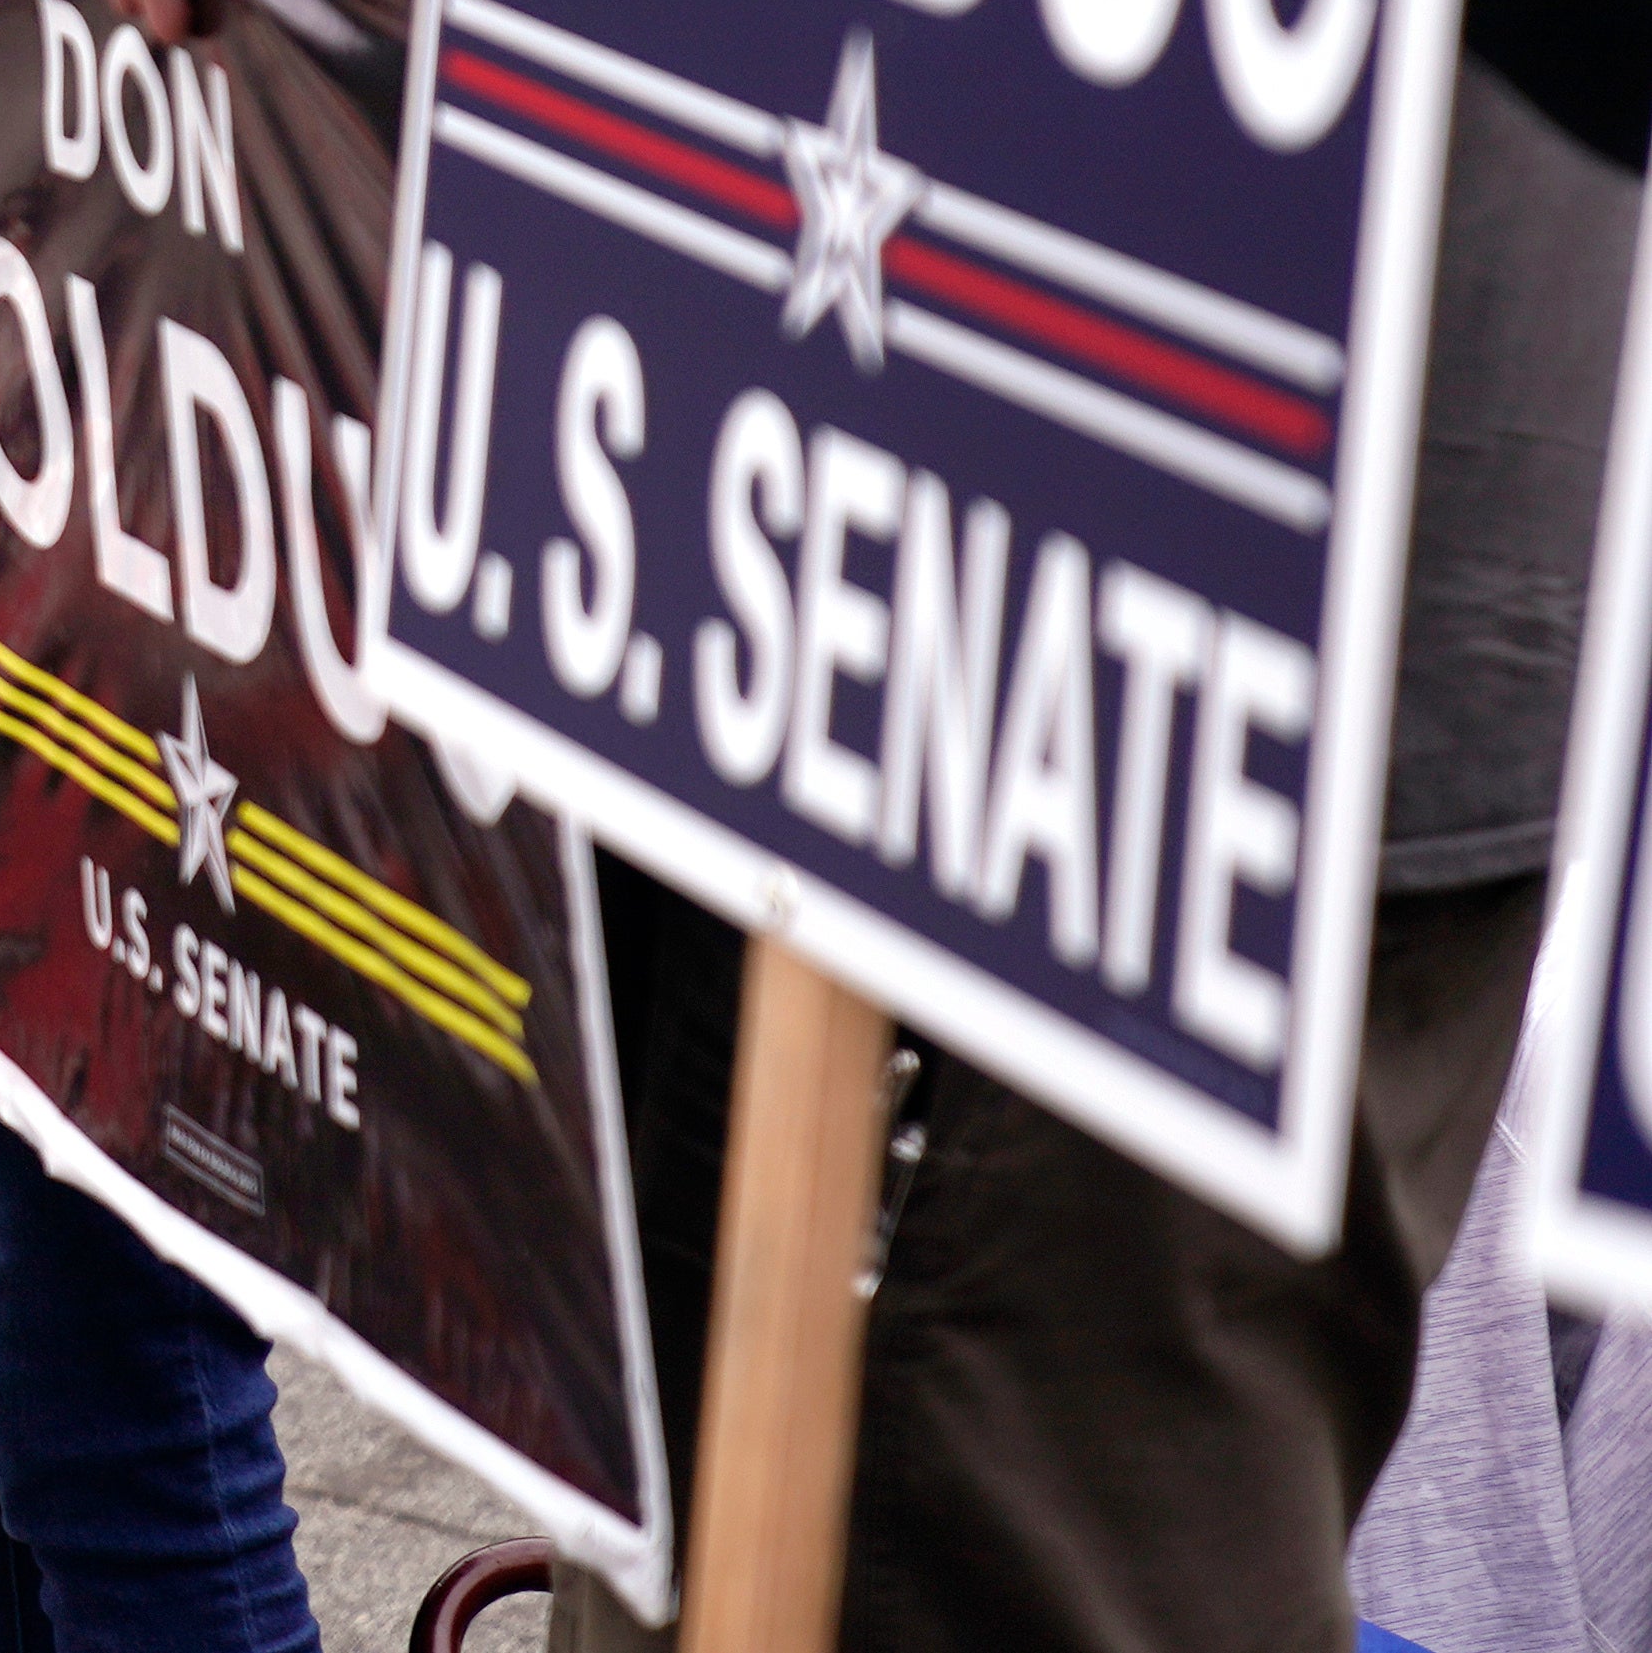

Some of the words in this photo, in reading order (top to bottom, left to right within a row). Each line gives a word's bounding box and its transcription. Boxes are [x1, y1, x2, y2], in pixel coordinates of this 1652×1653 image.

[693, 386, 1316, 1076] SENATE
[79, 854, 164, 994] U.S.
[172, 922, 361, 1132] SENATE
